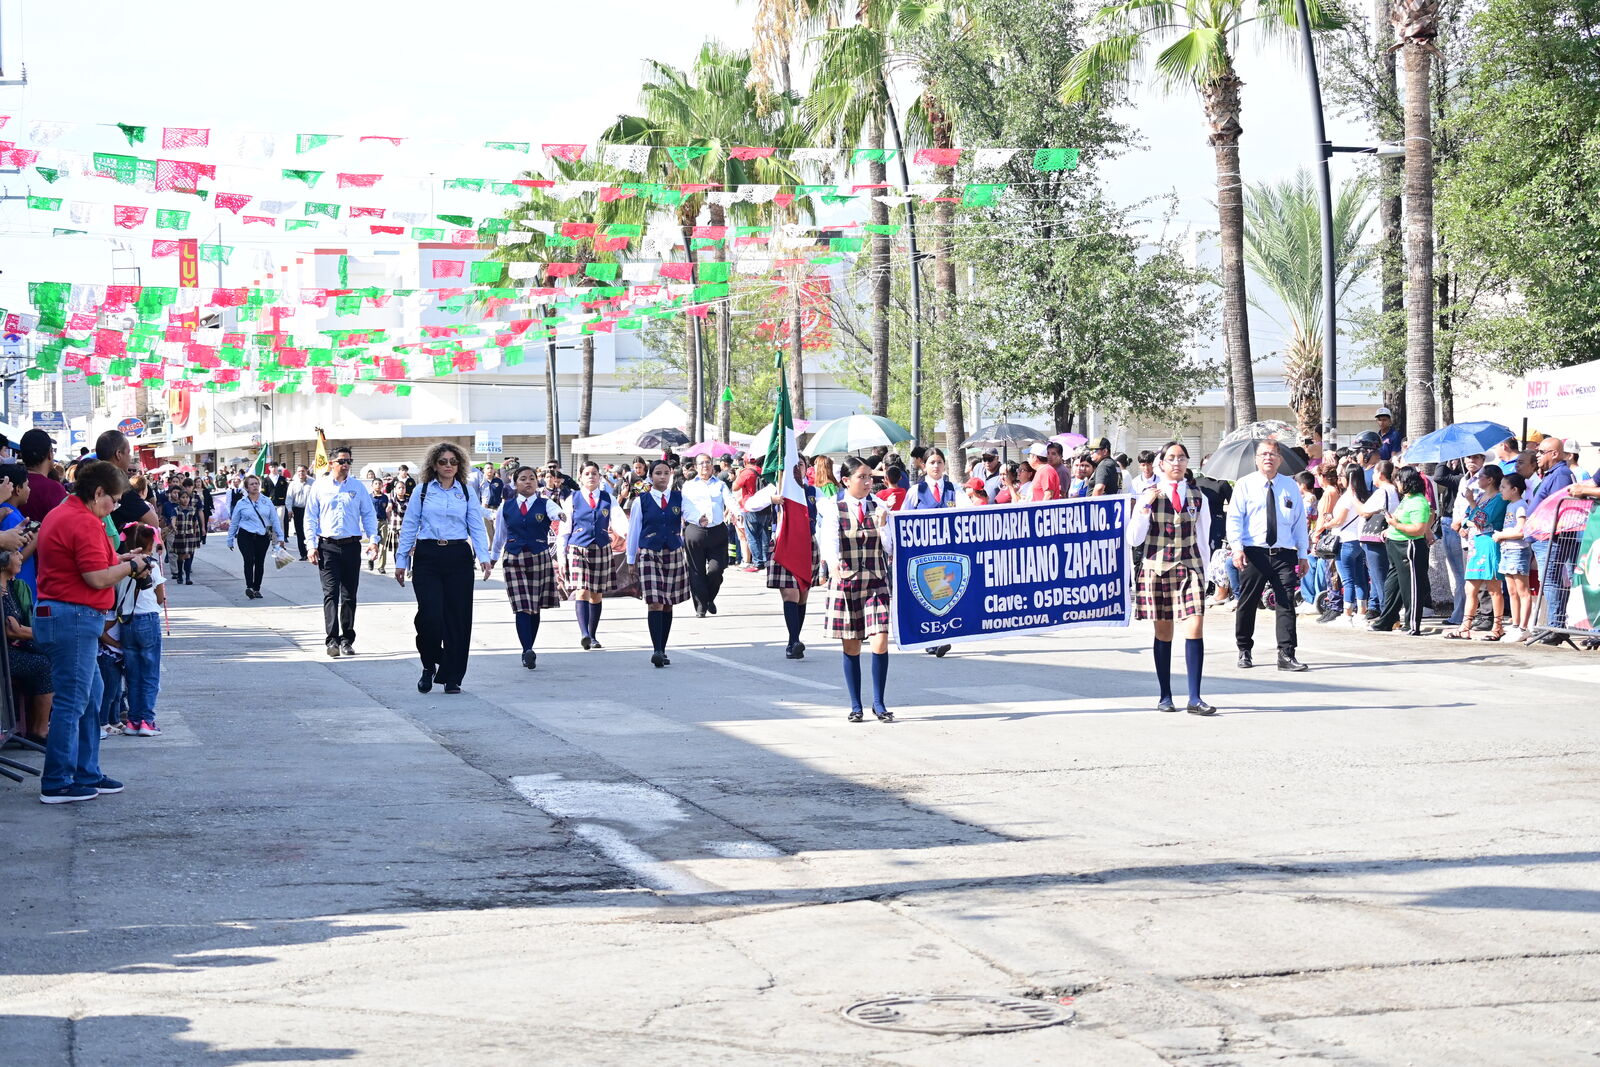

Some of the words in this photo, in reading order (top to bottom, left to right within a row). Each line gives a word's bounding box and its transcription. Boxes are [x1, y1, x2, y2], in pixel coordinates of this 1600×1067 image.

[1527, 381, 1551, 396] NRT
[1557, 384, 1577, 397] NRT
[1526, 399, 1549, 409] MEXICO
[899, 517, 951, 548] ESCUELA
[954, 511, 1031, 544] SECUNDARIA
[1034, 505, 1088, 538] GENERAL
[1113, 501, 1123, 529] 2
[914, 555, 957, 565] SECUNDARIA
[976, 543, 1059, 588] "EMILIANO
[1063, 537, 1121, 579] ZAPATA"
[984, 594, 1028, 613] Clave:
[1033, 578, 1121, 609] 05DES0019J
[981, 613, 1050, 630] MONCLOVA
[1062, 602, 1125, 621] COAHUILA.
[920, 617, 963, 634] SEyC
